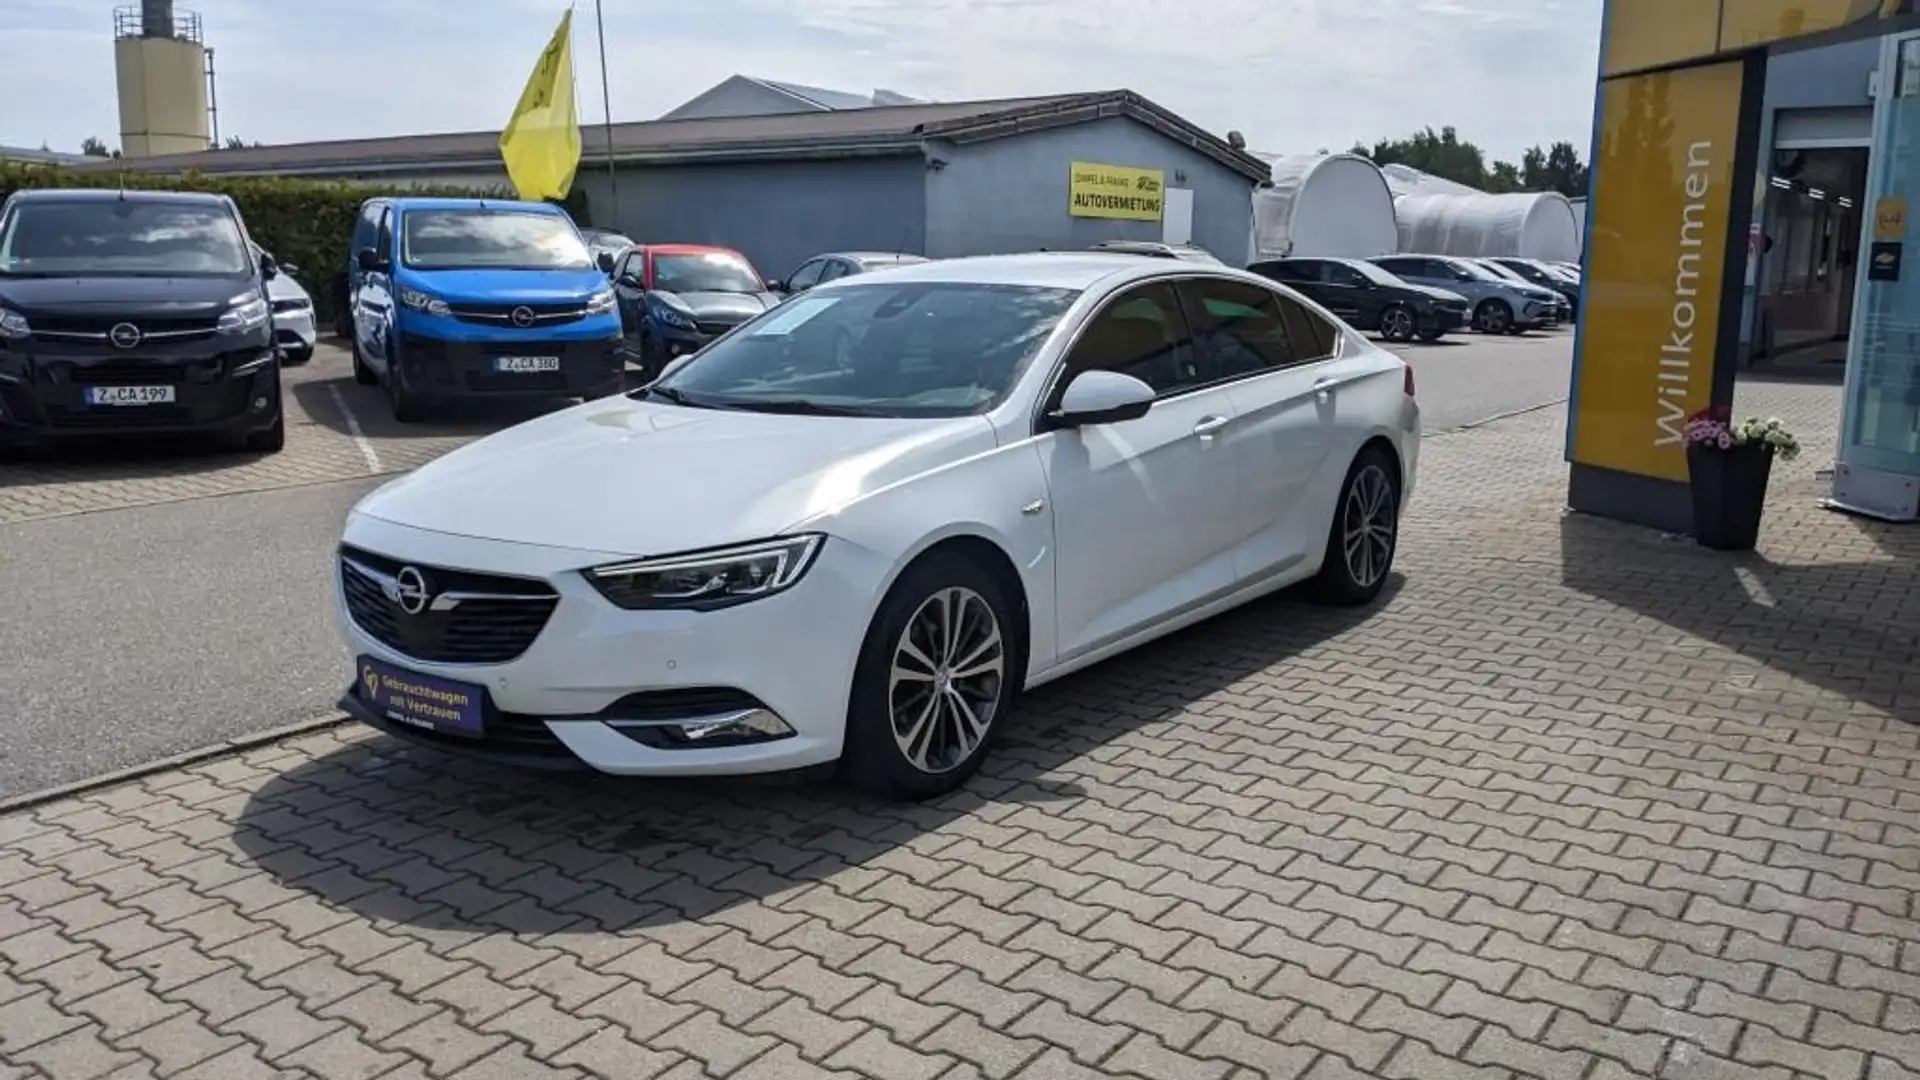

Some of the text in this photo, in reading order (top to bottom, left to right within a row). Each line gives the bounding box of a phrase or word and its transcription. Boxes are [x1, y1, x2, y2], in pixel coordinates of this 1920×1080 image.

[1074, 192, 1160, 212] AUTOVERMIETUNG
[1654, 140, 1711, 446] Willkommen
[382, 675, 468, 705] Gebrauchtwagen
[389, 695, 404, 708] mit
[407, 697, 461, 721] Vertrauen
